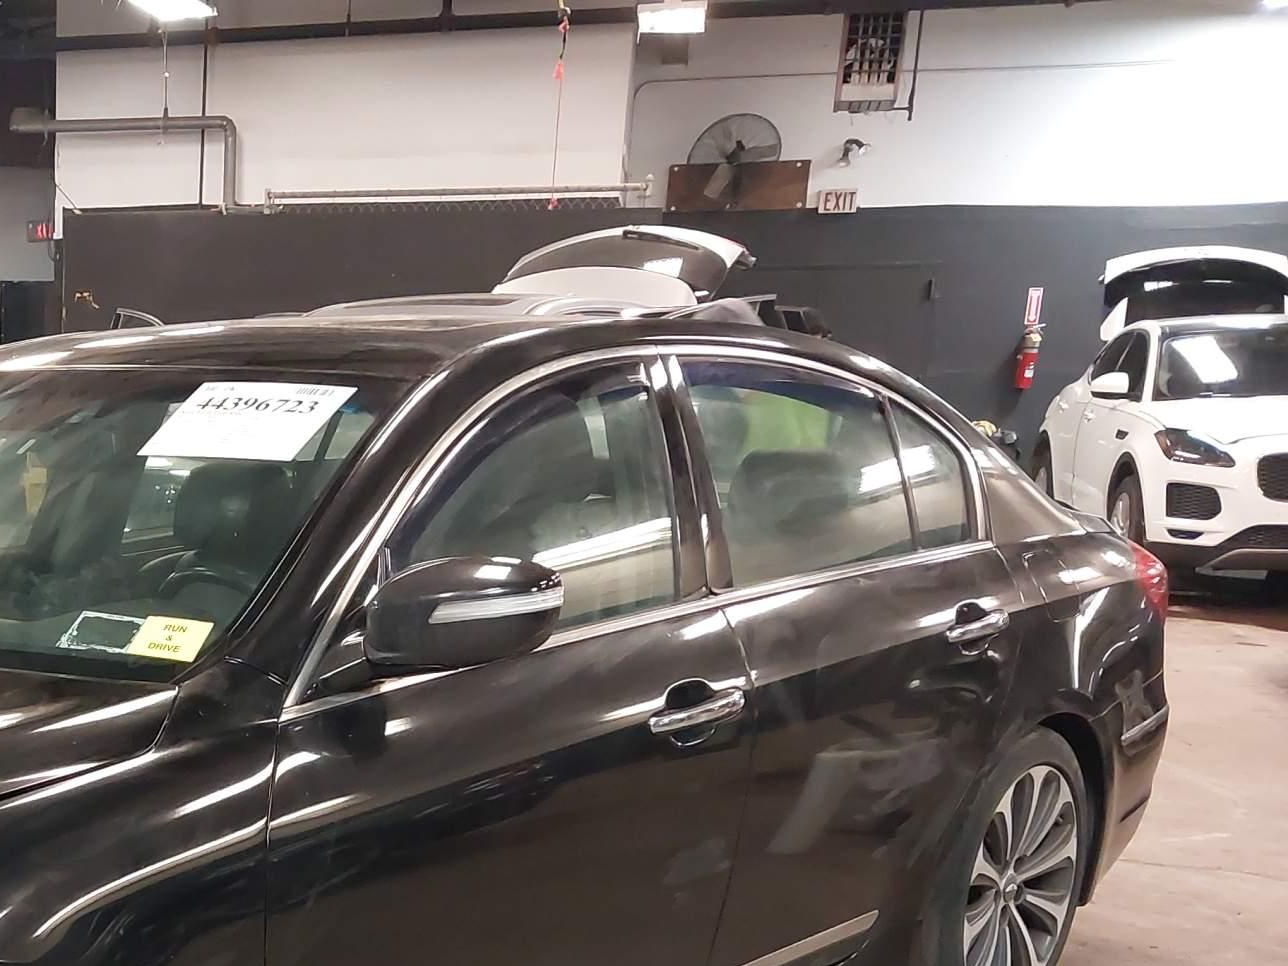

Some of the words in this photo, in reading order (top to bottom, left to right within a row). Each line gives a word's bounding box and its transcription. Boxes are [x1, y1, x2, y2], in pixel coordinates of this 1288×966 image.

[823, 192, 856, 211] EXIT
[196, 396, 320, 414] 44396723
[163, 624, 188, 633] RUN
[147, 642, 182, 653] DRIVE
